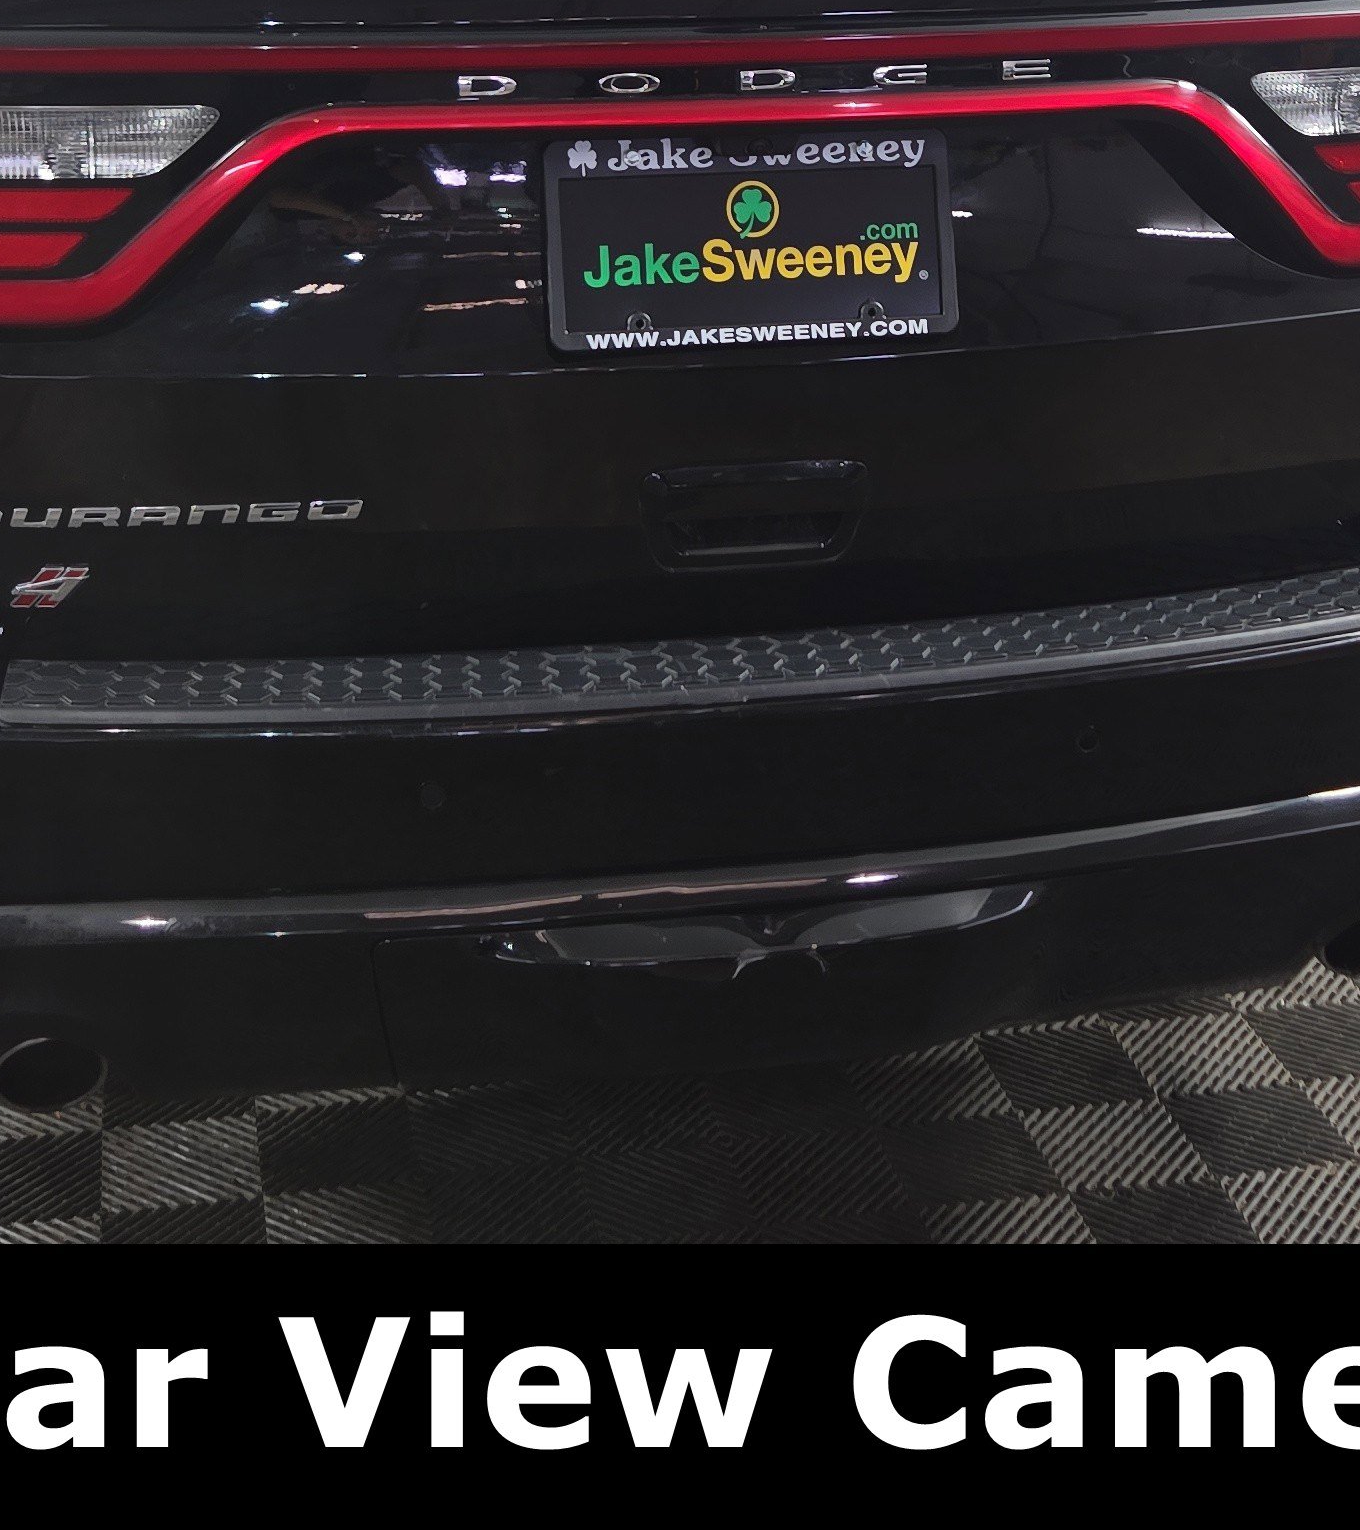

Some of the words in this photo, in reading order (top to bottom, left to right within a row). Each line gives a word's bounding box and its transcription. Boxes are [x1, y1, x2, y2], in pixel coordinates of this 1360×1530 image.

[458, 58, 1052, 97] DODGE
[607, 138, 714, 171] Jake
[586, 318, 929, 350] WWW.JAKESWEENEY.COM
